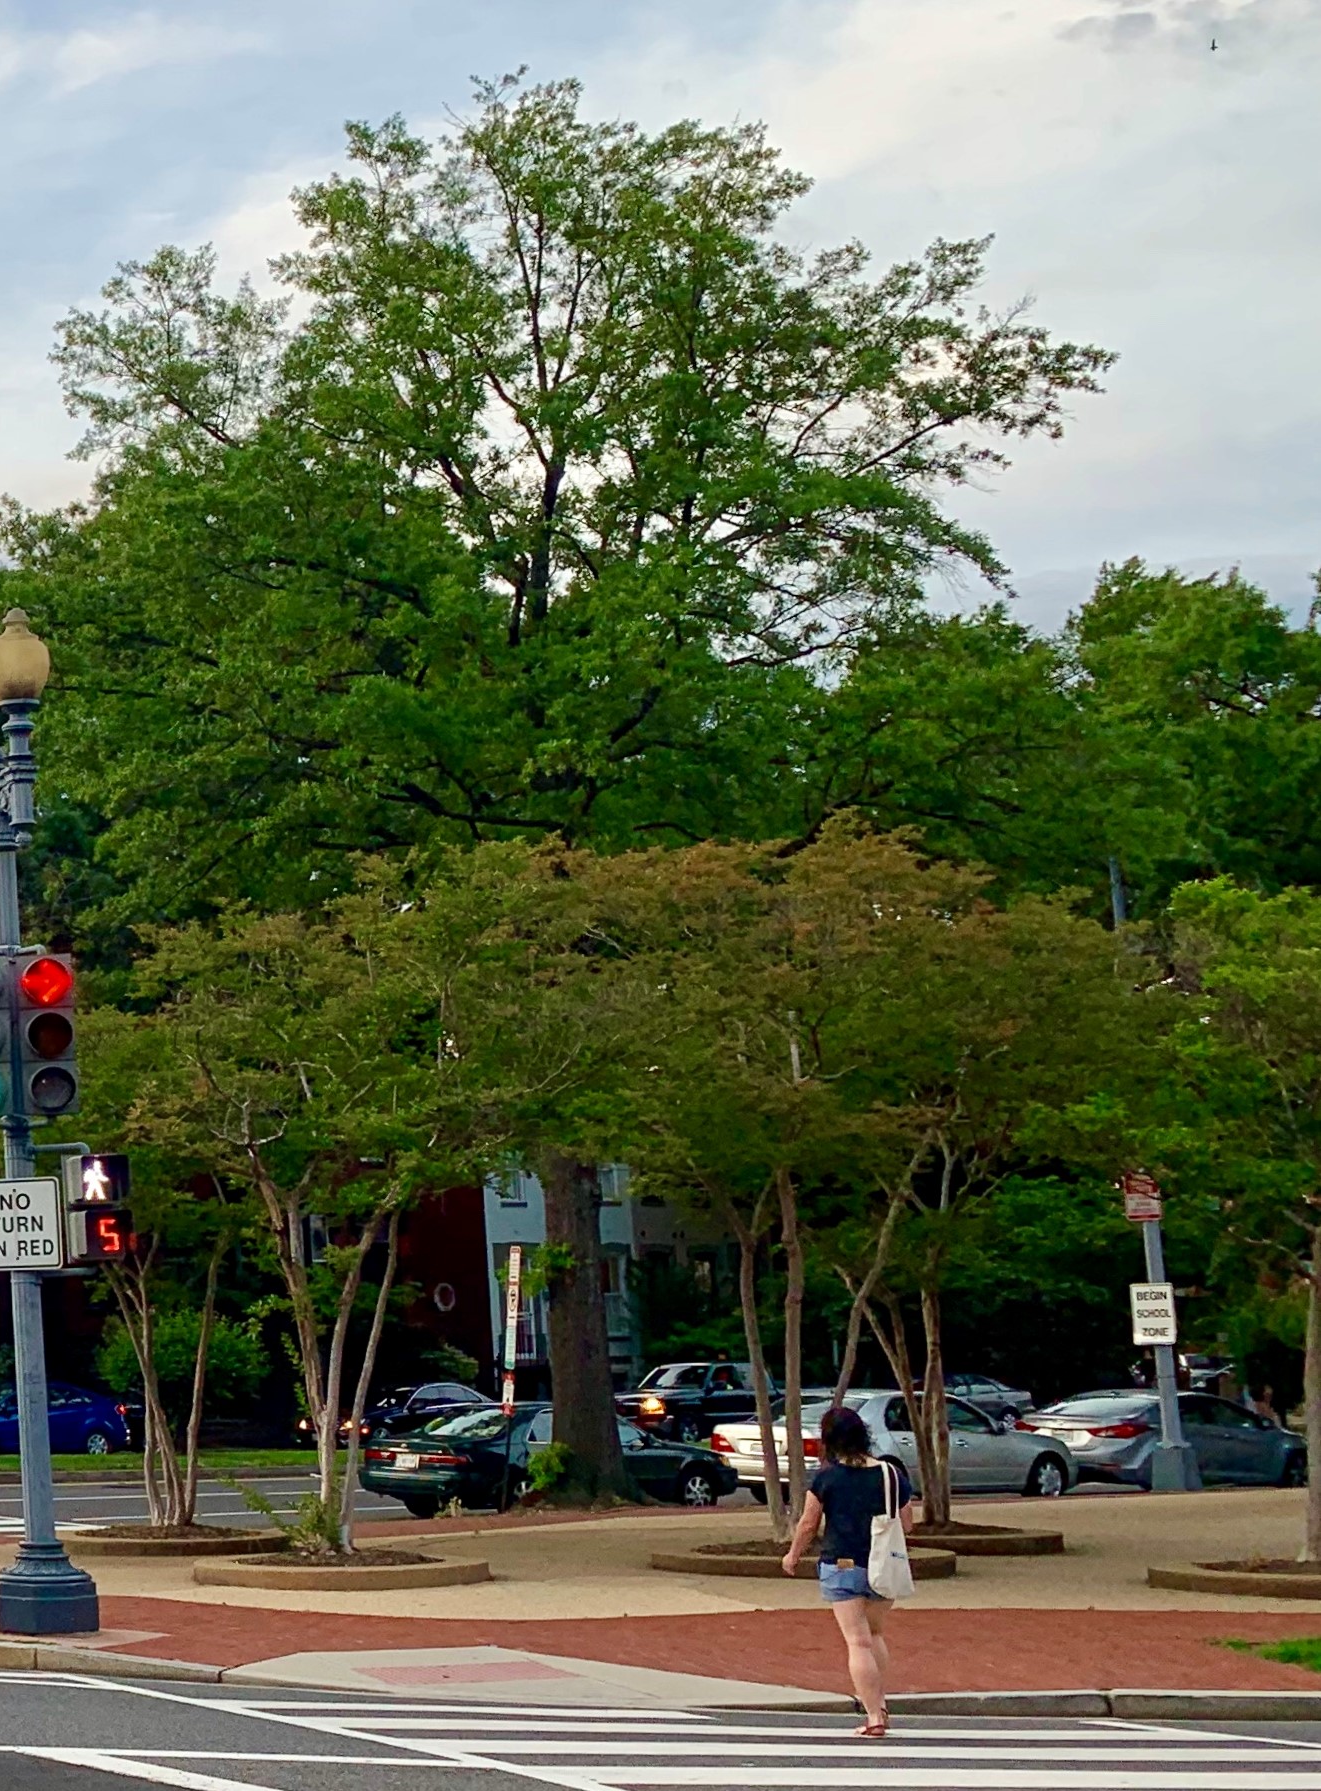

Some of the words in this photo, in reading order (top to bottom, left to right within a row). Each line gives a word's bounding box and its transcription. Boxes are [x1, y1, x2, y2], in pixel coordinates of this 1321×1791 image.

[0, 1193, 31, 1211] NO
[99, 1218, 120, 1252] 5
[17, 1239, 55, 1257] RED
[1136, 1291, 1168, 1301] BEGIN
[1136, 1308, 1172, 1319] SCHOOL
[1141, 1327, 1170, 1337] ZONE
